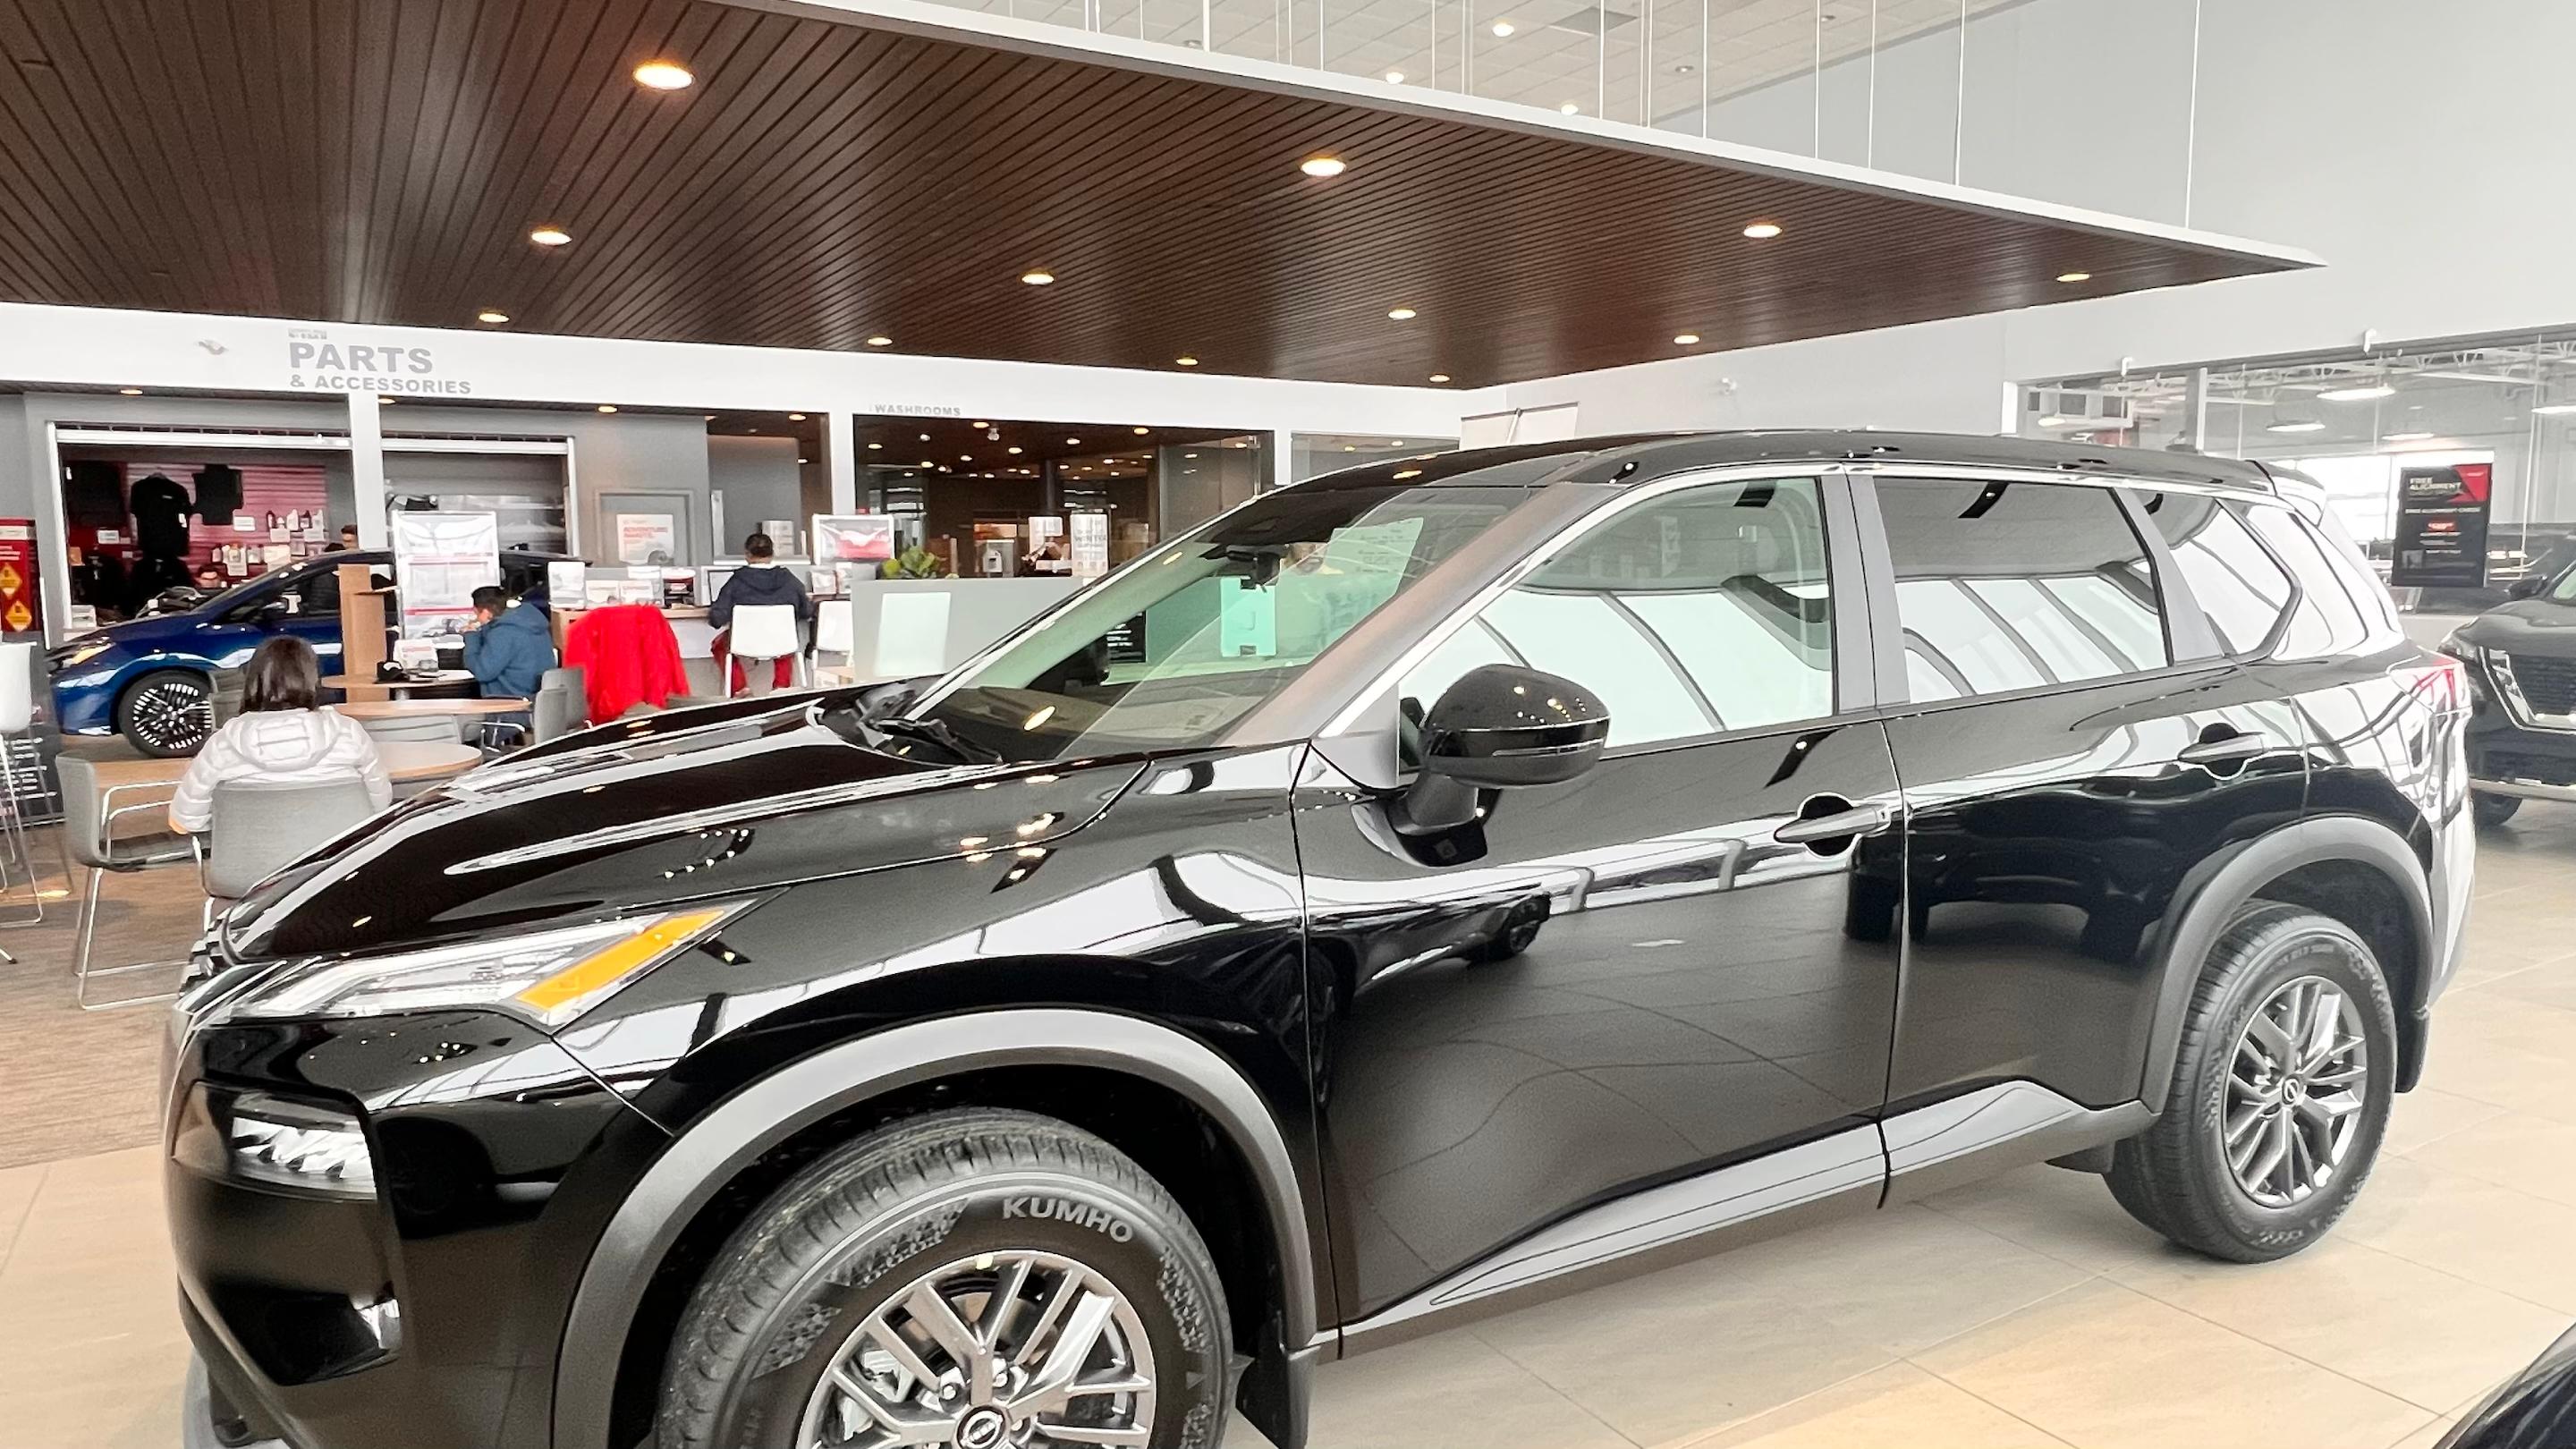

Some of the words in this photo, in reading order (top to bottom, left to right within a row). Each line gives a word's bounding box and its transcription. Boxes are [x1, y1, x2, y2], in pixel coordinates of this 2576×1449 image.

[289, 342, 433, 374] PARTS
[290, 374, 306, 387] &
[315, 375, 471, 394] ACCESSORIES
[874, 403, 962, 417] WASHROOMS
[1002, 1197, 1134, 1243] KUMHO
